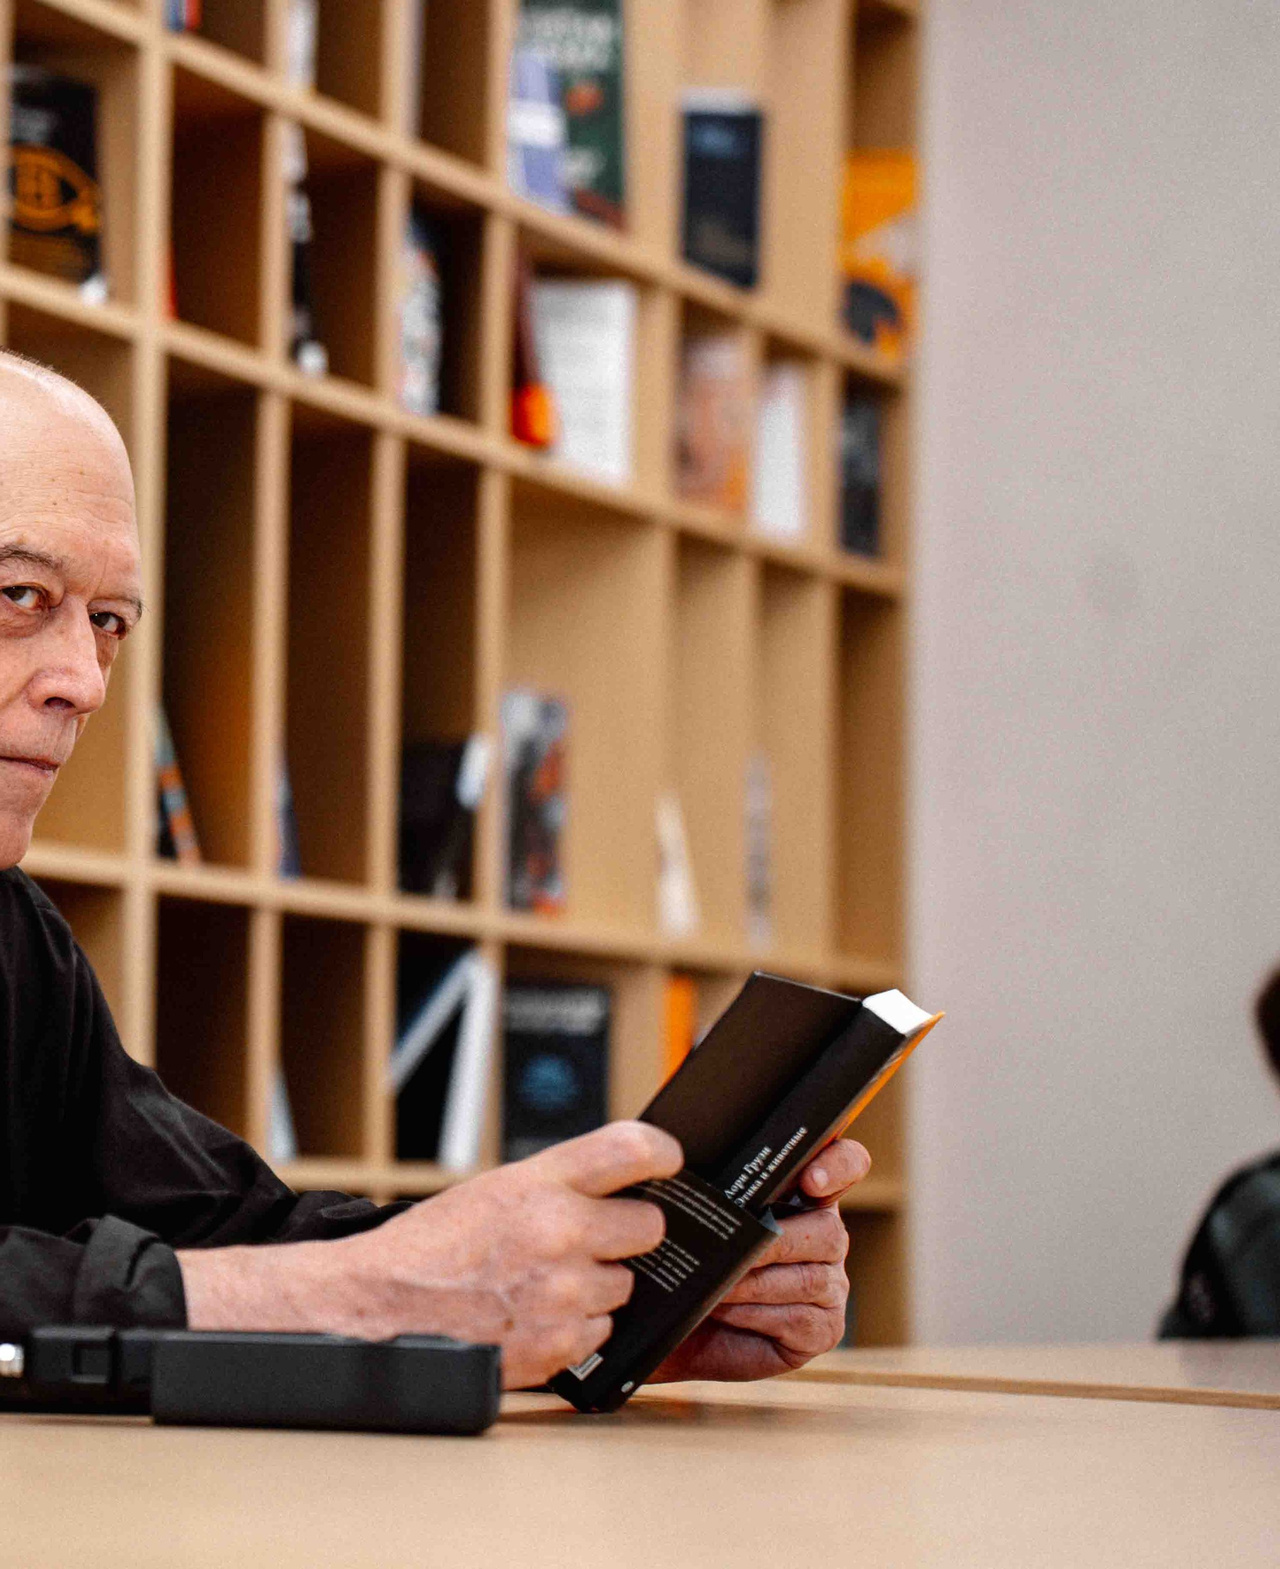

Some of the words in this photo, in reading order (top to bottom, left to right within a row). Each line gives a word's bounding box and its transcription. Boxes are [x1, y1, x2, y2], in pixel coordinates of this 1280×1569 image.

[724, 1173, 749, 1199] Лори
[743, 1146, 772, 1174] Груэн
[734, 1180, 763, 1207] Этика
[759, 1171, 770, 1181] и
[766, 1126, 808, 1173] животные
